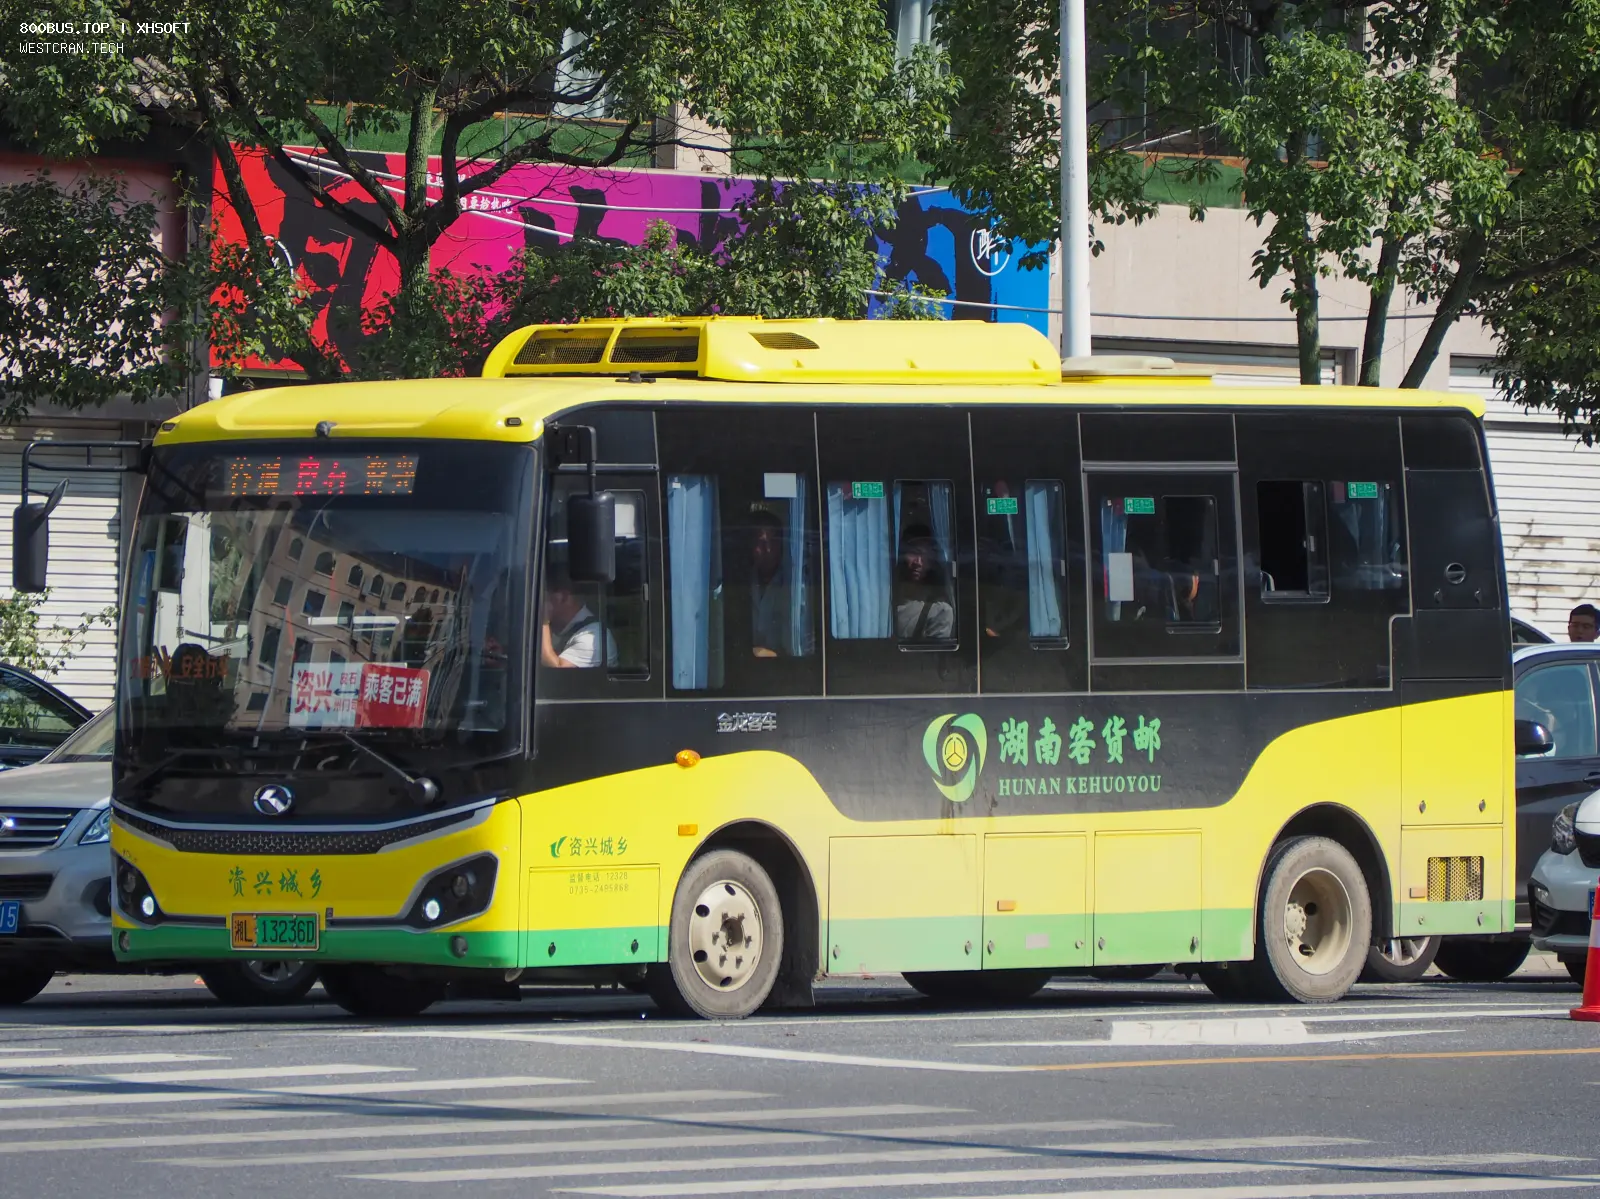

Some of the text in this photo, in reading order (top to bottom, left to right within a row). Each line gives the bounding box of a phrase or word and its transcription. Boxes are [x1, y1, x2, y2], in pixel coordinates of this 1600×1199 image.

[294, 669, 333, 713] 资兴
[364, 672, 423, 708] 乘客已满
[717, 712, 777, 732] 金龙客车
[998, 714, 1162, 767] 湖南客货邮
[998, 775, 1162, 796] HUNAN KEHUOYOU
[569, 836, 628, 857] 资兴城乡
[228, 866, 324, 899] 资兴城乡
